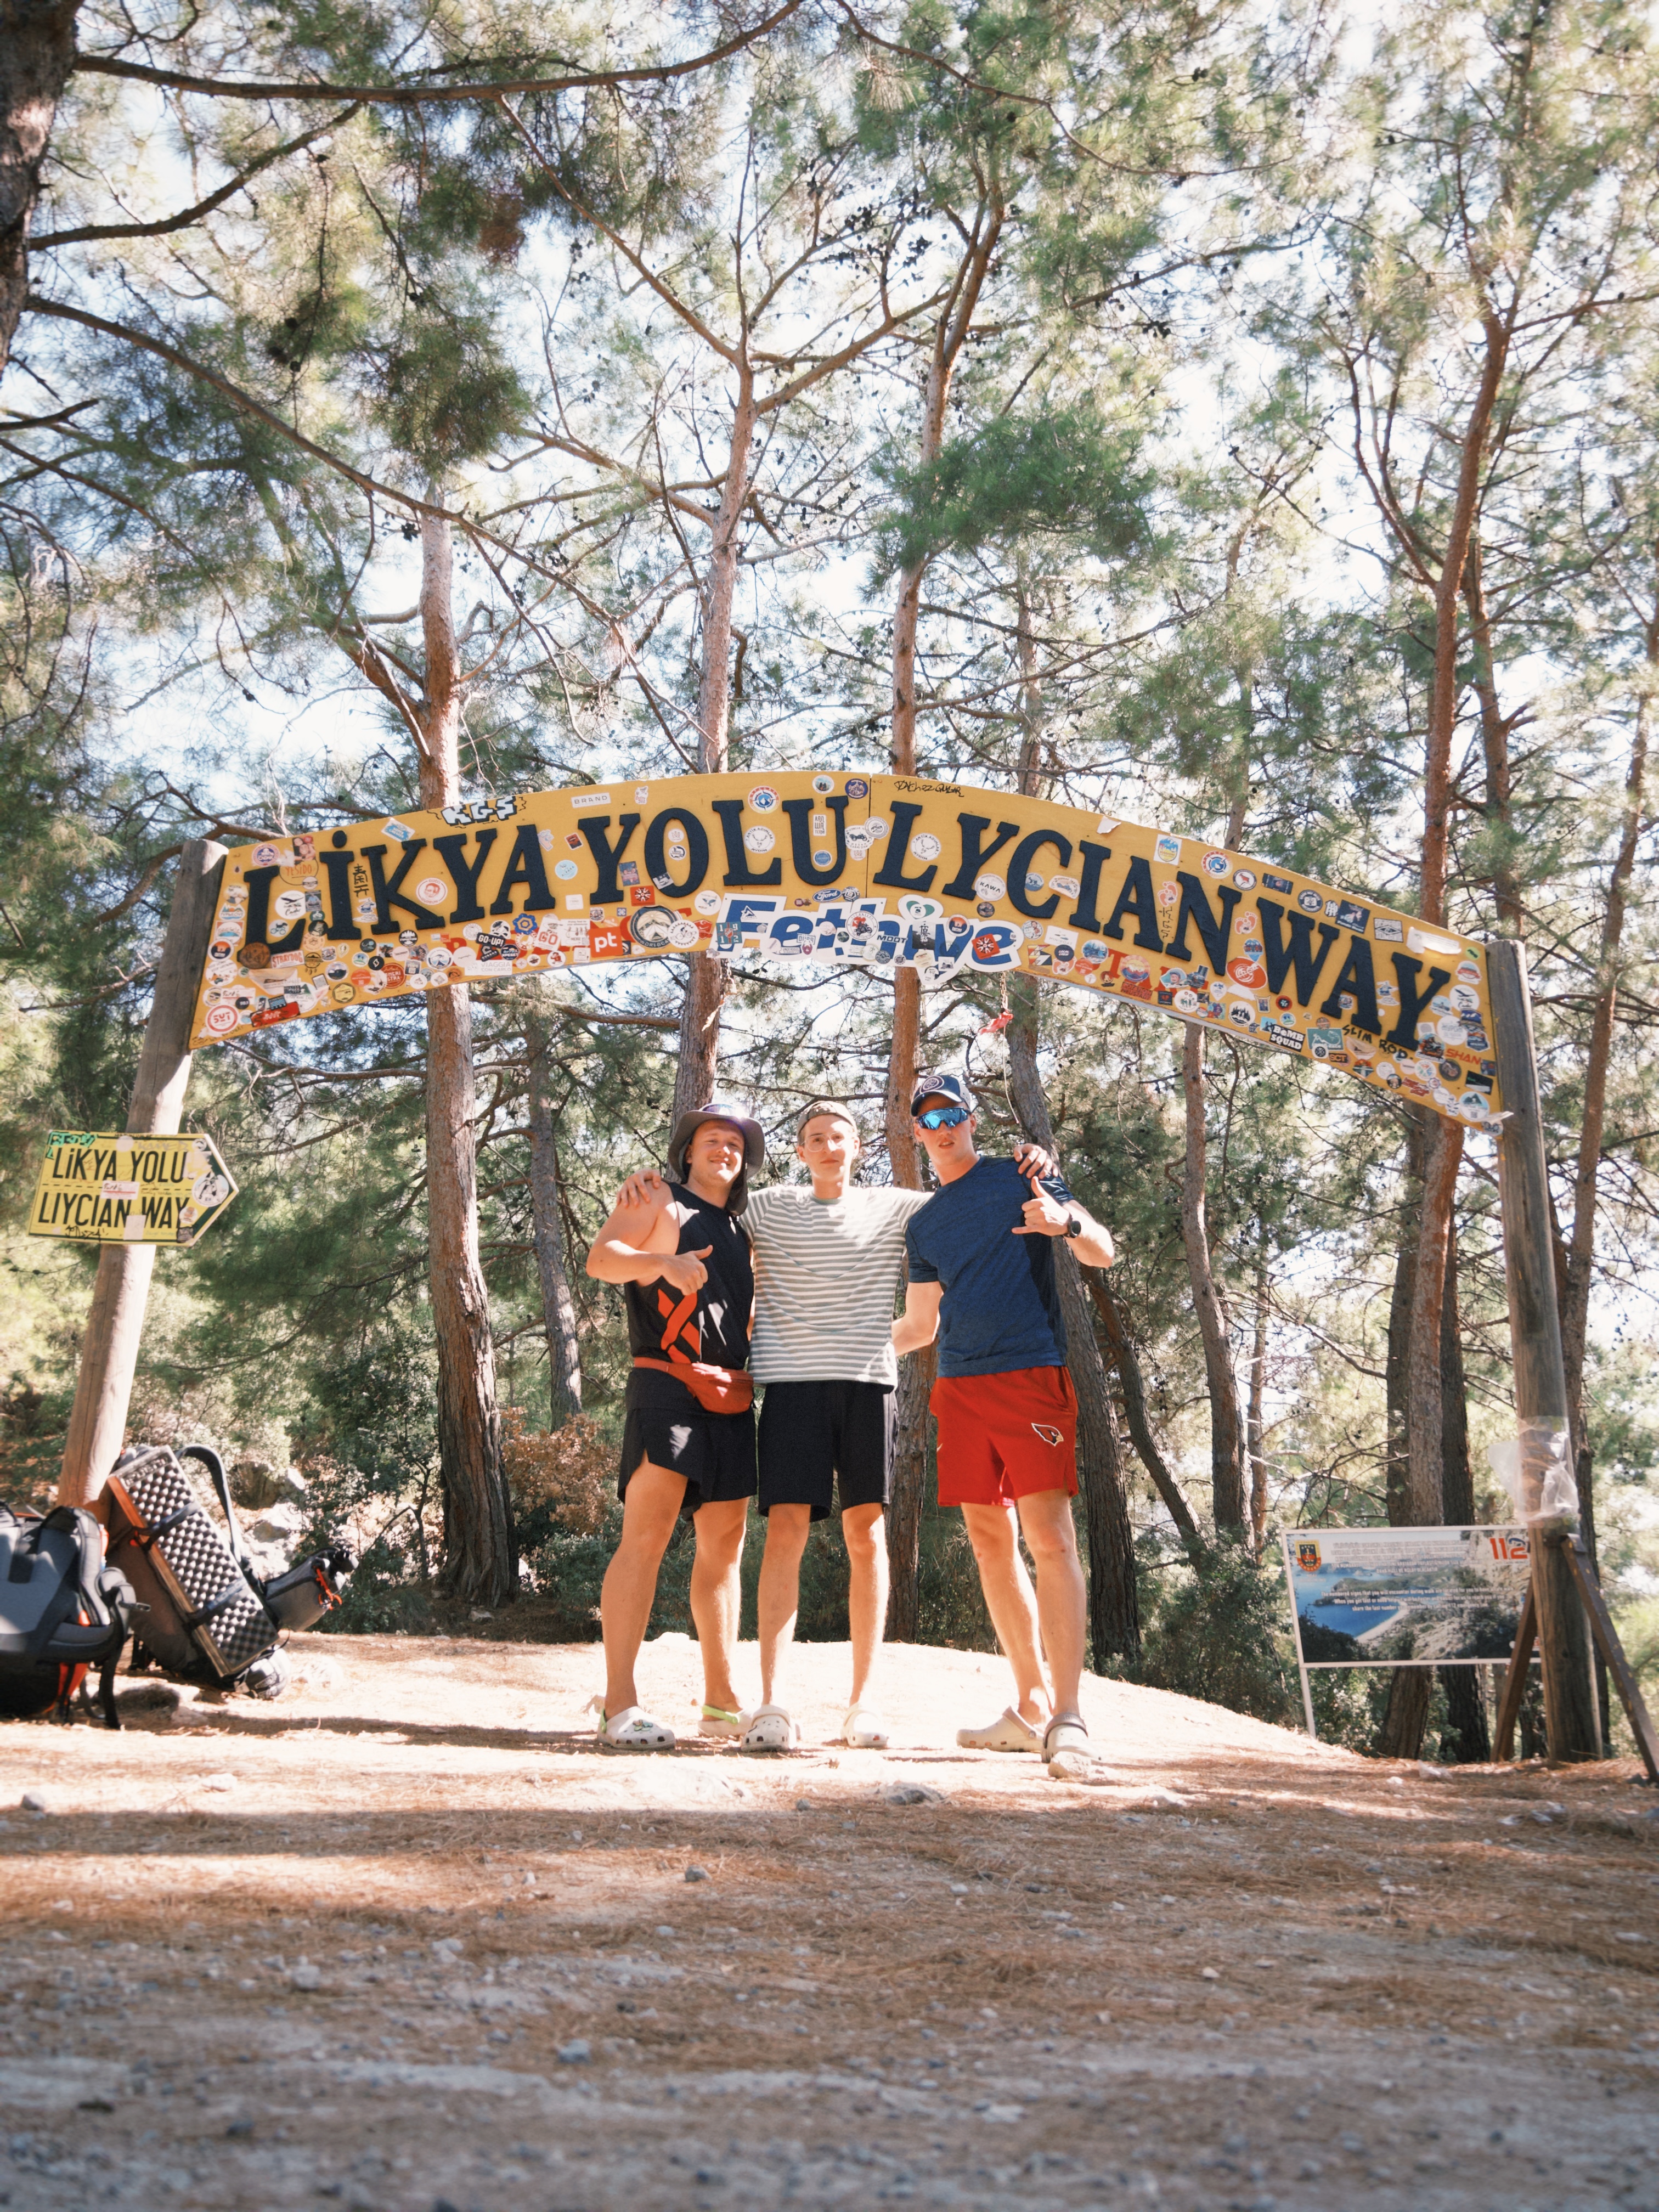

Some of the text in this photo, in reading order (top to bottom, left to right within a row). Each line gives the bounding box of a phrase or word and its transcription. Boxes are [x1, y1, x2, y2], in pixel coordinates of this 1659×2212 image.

[574, 795, 607, 804] BRAND
[441, 795, 517, 826] KGS
[818, 890, 838, 900] Ford
[980, 882, 1001, 893] KAWA
[578, 795, 848, 905] YOLU
[873, 801, 1242, 975] LYCIAN
[1257, 897, 1451, 1051] WAY
[538, 932, 558, 945] GO
[595, 932, 617, 952] pt
[877, 935, 908, 943] MOOT
[272, 952, 303, 967] STRAYDOG
[1271, 1034, 1302, 1050] SQUAD
[1342, 1025, 1372, 1043] SLIM
[1329, 1054, 1346, 1063] SCT
[1446, 1048, 1482, 1065] SHAN
[131, 1150, 189, 1183] YOLU
[38, 1192, 190, 1229] LIYCIAN WAY
[1489, 1538, 1528, 1559] 112
